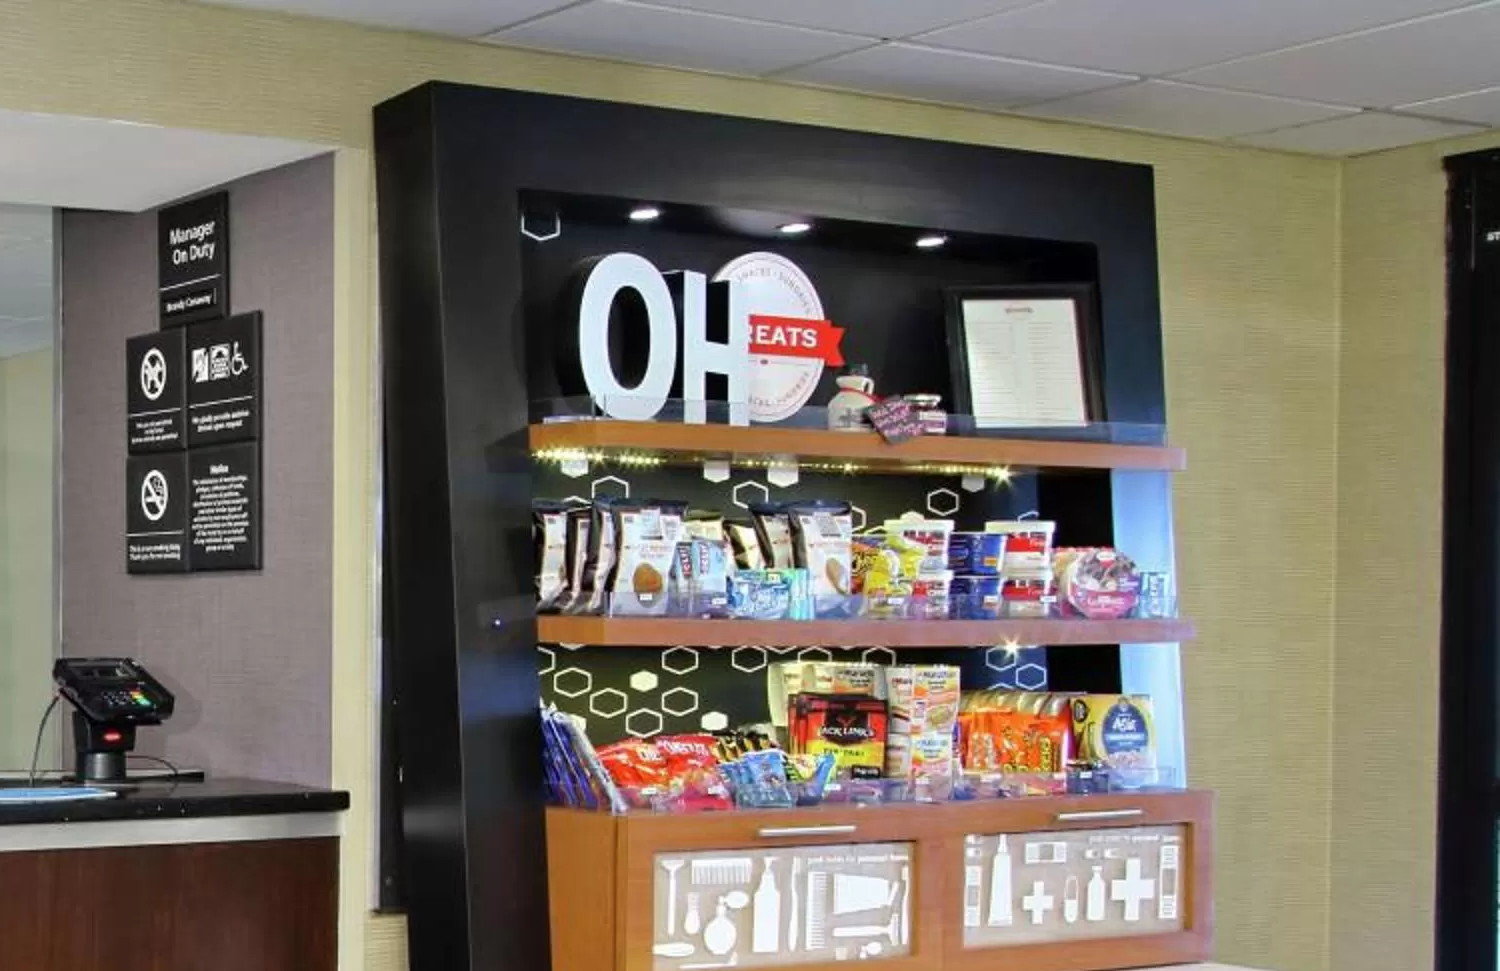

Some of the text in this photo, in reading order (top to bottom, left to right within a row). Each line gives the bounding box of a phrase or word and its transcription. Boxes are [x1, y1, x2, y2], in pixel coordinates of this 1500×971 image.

[169, 221, 216, 245] Manager
[172, 243, 216, 265] On Duty
[579, 251, 750, 427] OH
[749, 325, 818, 348] EATS
